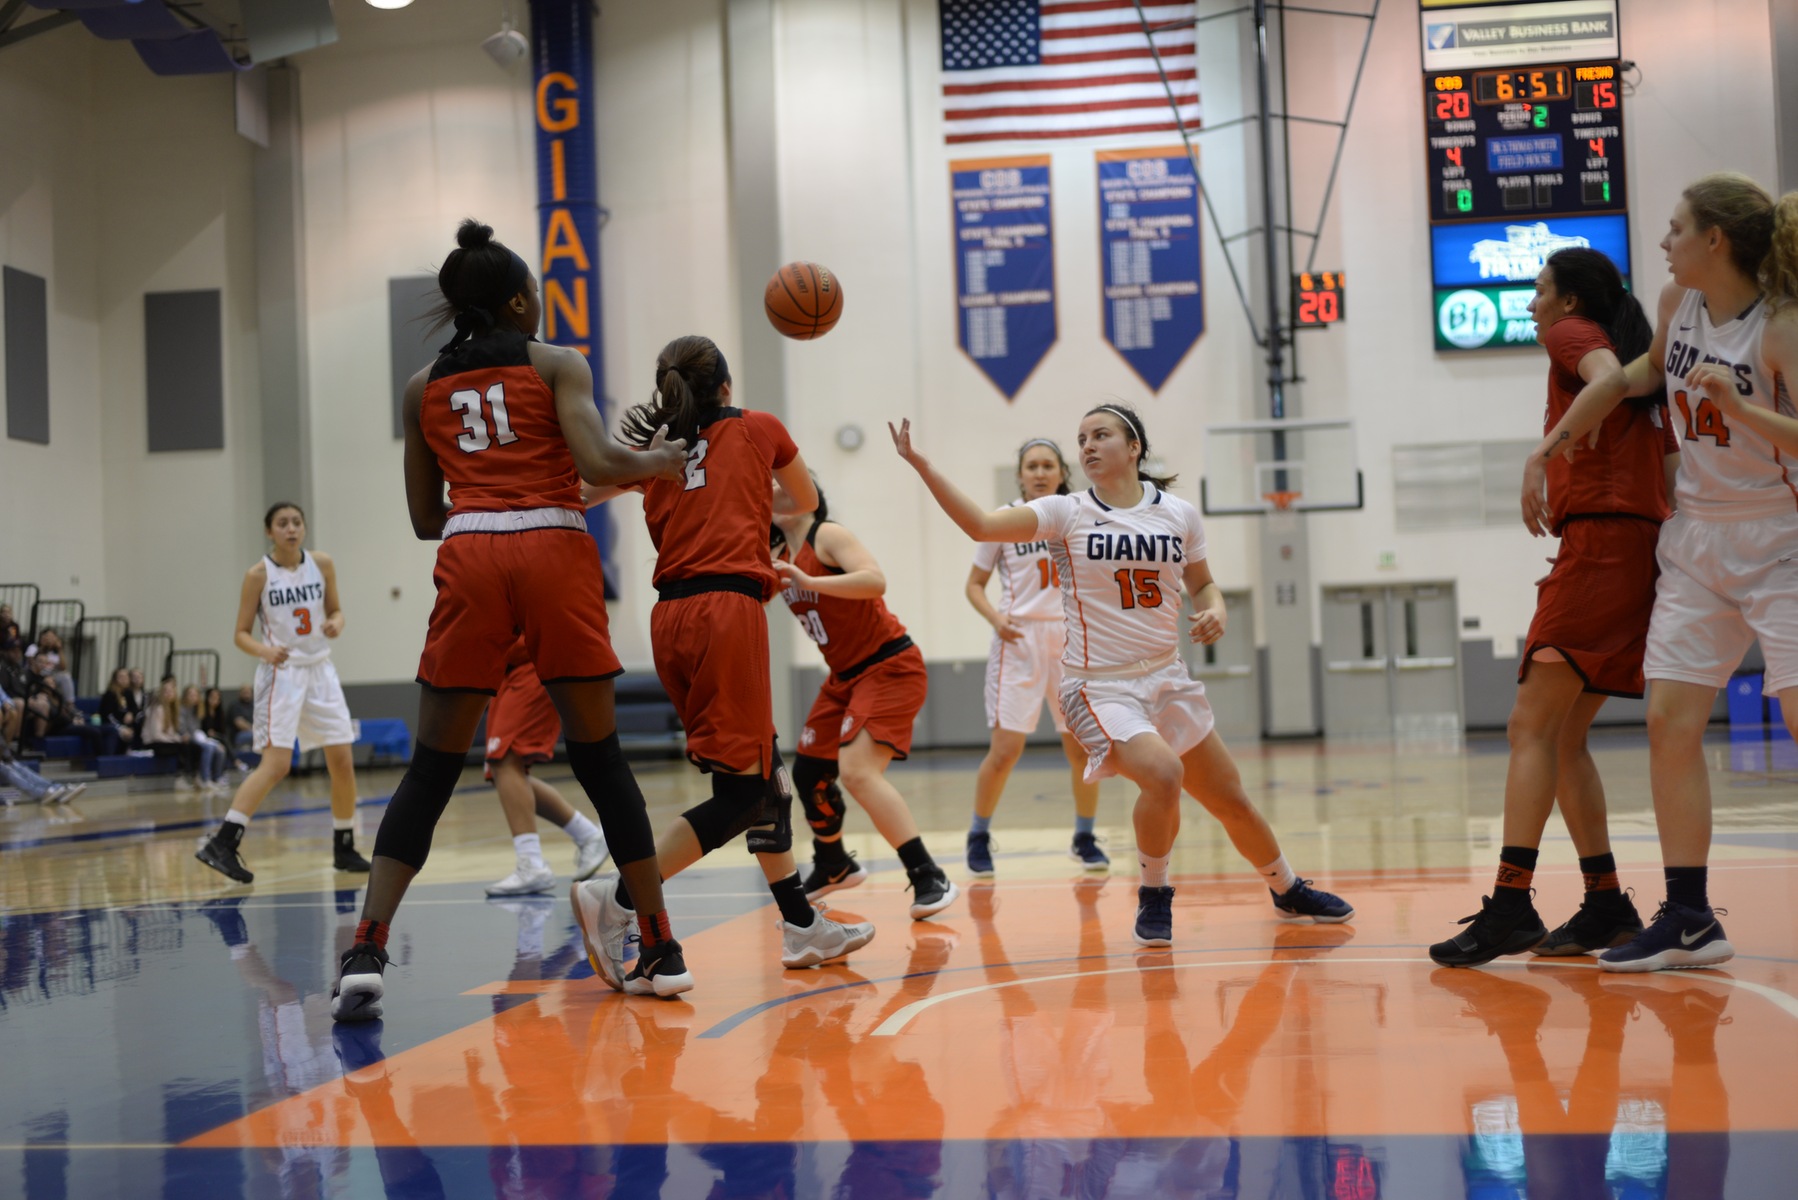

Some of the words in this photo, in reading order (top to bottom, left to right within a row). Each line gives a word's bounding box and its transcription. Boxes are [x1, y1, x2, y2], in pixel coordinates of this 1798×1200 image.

[1462, 26, 1506, 42] VALLEY
[1509, 22, 1569, 38] BUSINESS
[1571, 20, 1608, 35] BANK
[1496, 70, 1564, 100] 6:51
[1592, 82, 1616, 108] 15
[1436, 92, 1470, 119] 20
[1533, 105, 1548, 128] 2
[1444, 120, 1476, 132] BONUS
[1571, 111, 1602, 124] BONUS
[1431, 135, 1476, 149] TIMEOUTS
[1573, 126, 1619, 140] TIMEOUTS
[1446, 146, 1461, 166] 4
[1589, 138, 1604, 157] 4
[1586, 157, 1608, 169] LEFT
[1497, 175, 1531, 188] PLAYER
[1534, 173, 1563, 186] FOULS
[1603, 181, 1611, 202] 1
[1457, 189, 1473, 212] 0
[535, 72, 591, 355] GIAN
[1299, 291, 1338, 323] 20
[1666, 340, 1754, 396] GIAS
[450, 382, 520, 453] 31
[1674, 389, 1731, 447] 14
[1015, 539, 1048, 556] GIA
[1087, 533, 1183, 563] GIANTS
[269, 583, 322, 606] GIANTS
[1114, 568, 1163, 609] 15
[293, 607, 312, 636] 3
